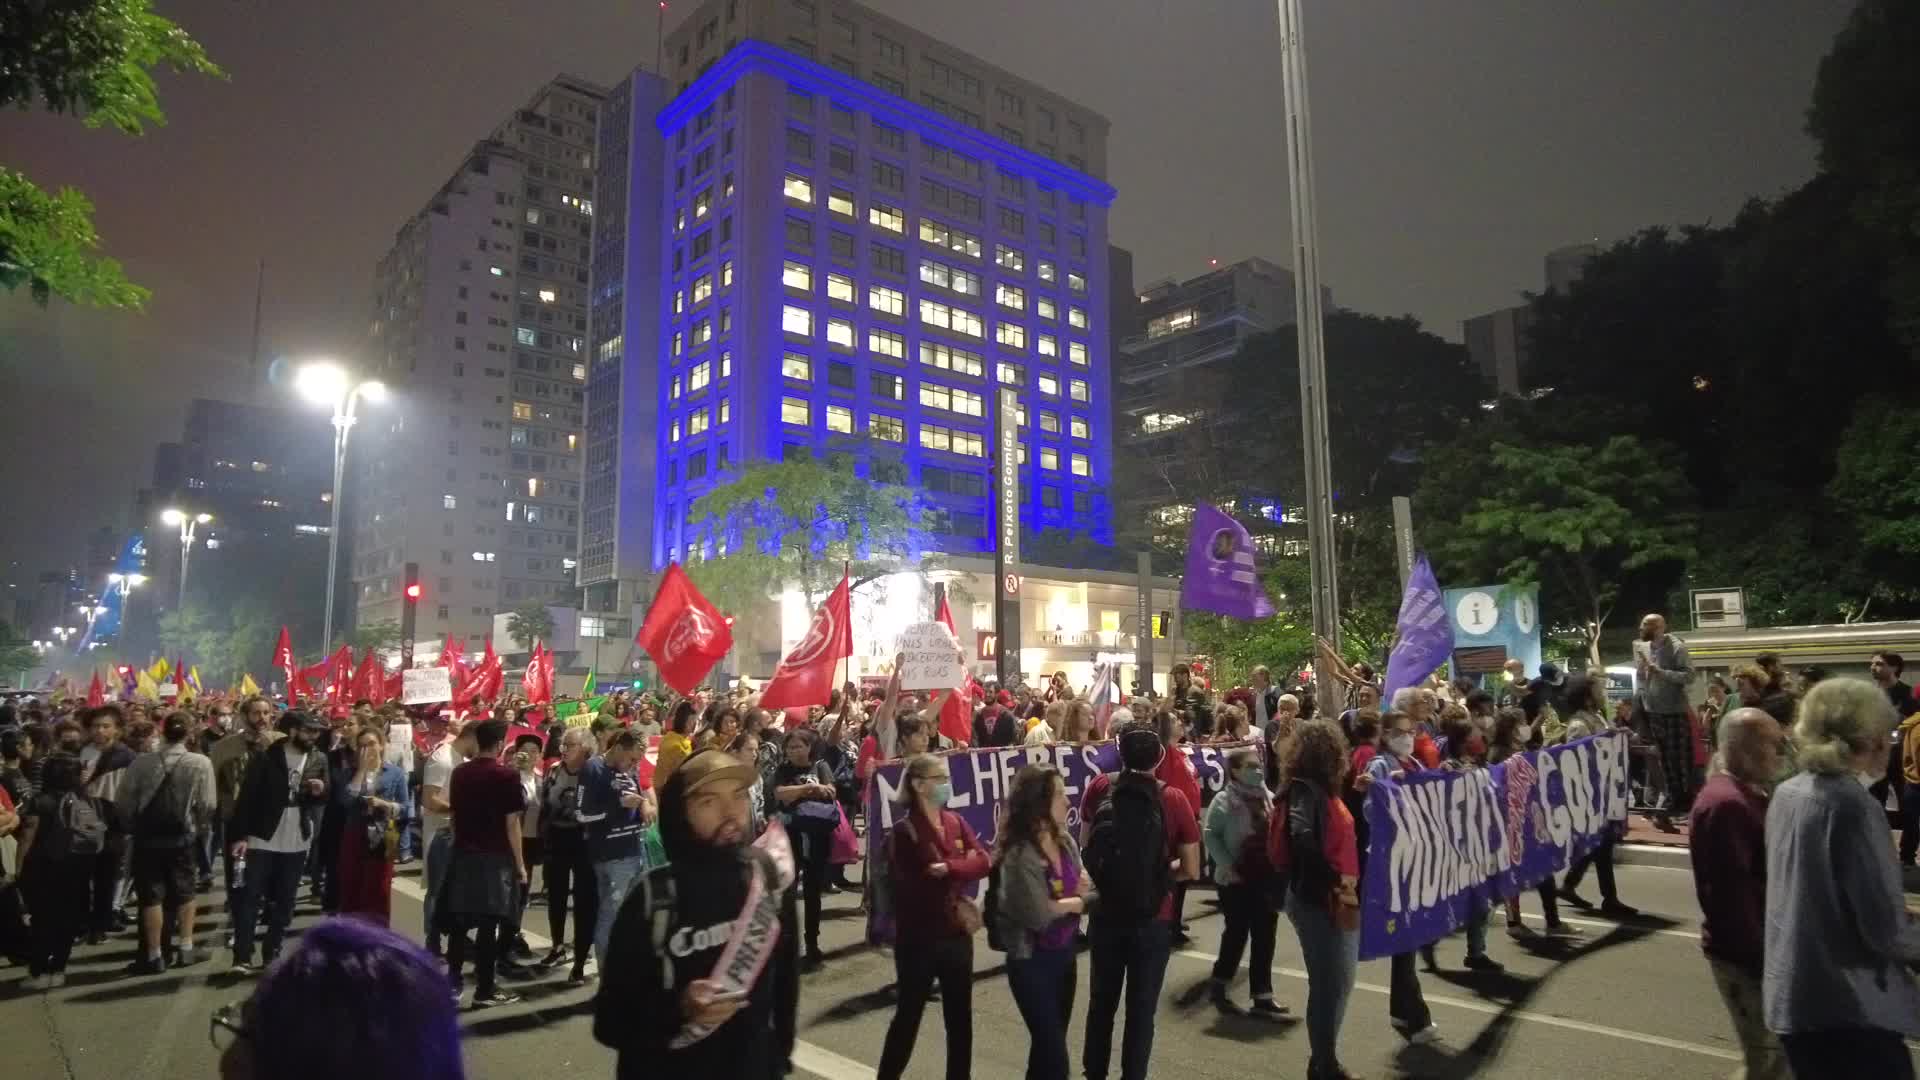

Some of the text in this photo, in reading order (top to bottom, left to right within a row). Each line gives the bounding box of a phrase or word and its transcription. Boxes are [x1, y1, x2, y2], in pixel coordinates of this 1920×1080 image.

[1003, 430, 1014, 565] R. Peixoto Gomide
[877, 744, 1101, 829] MLHEES
